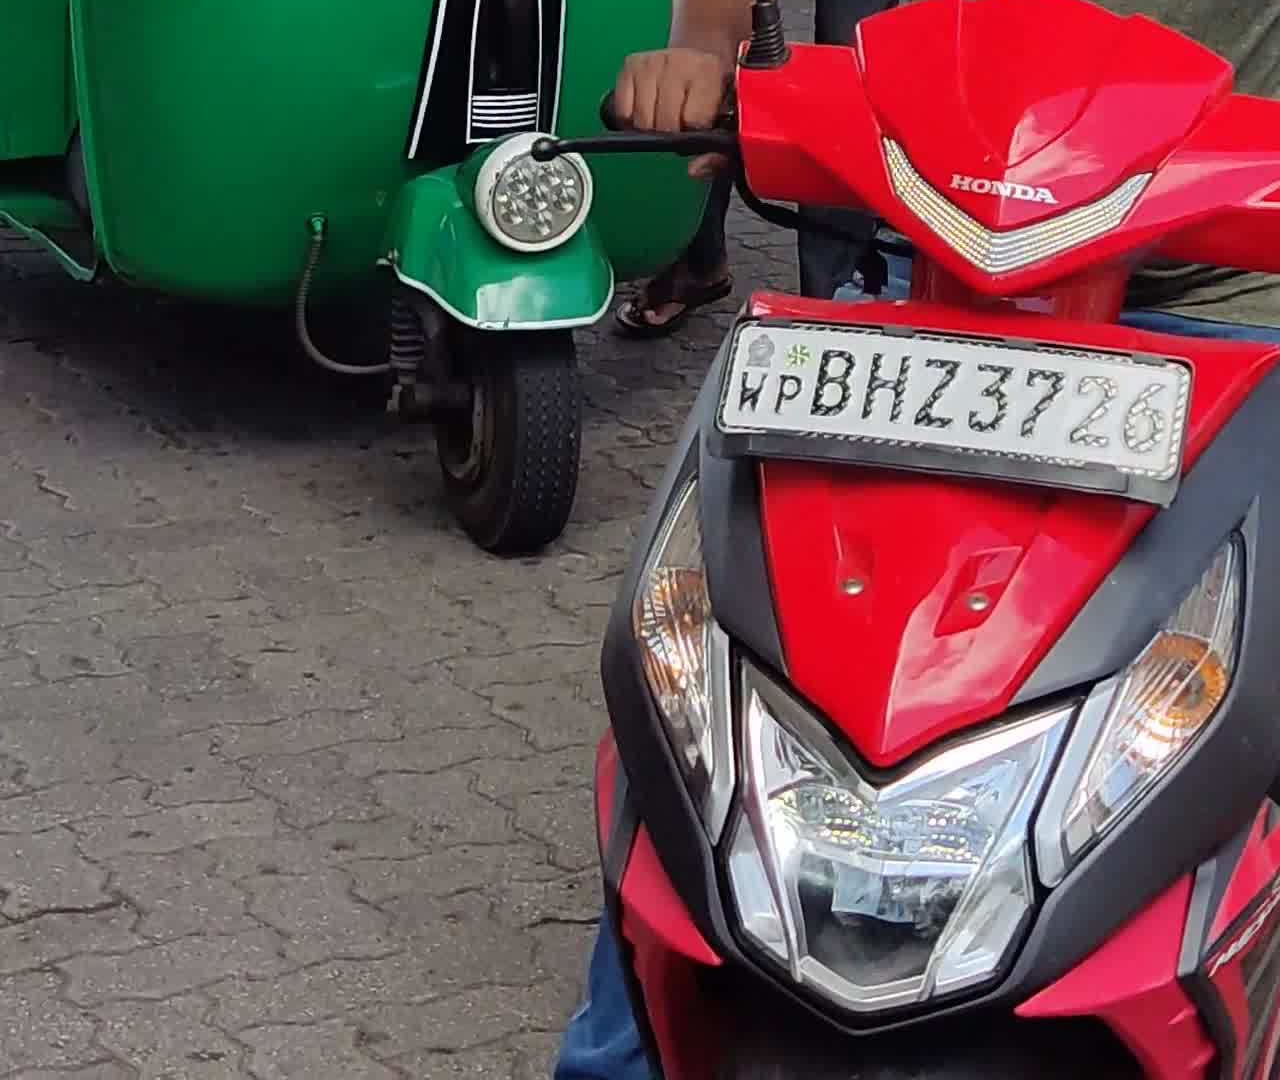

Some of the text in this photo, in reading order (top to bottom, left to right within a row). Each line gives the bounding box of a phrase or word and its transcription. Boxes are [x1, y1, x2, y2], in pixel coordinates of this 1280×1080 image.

[950, 173, 1060, 205] HONDA
[738, 349, 1166, 455] WP BHZ3726
